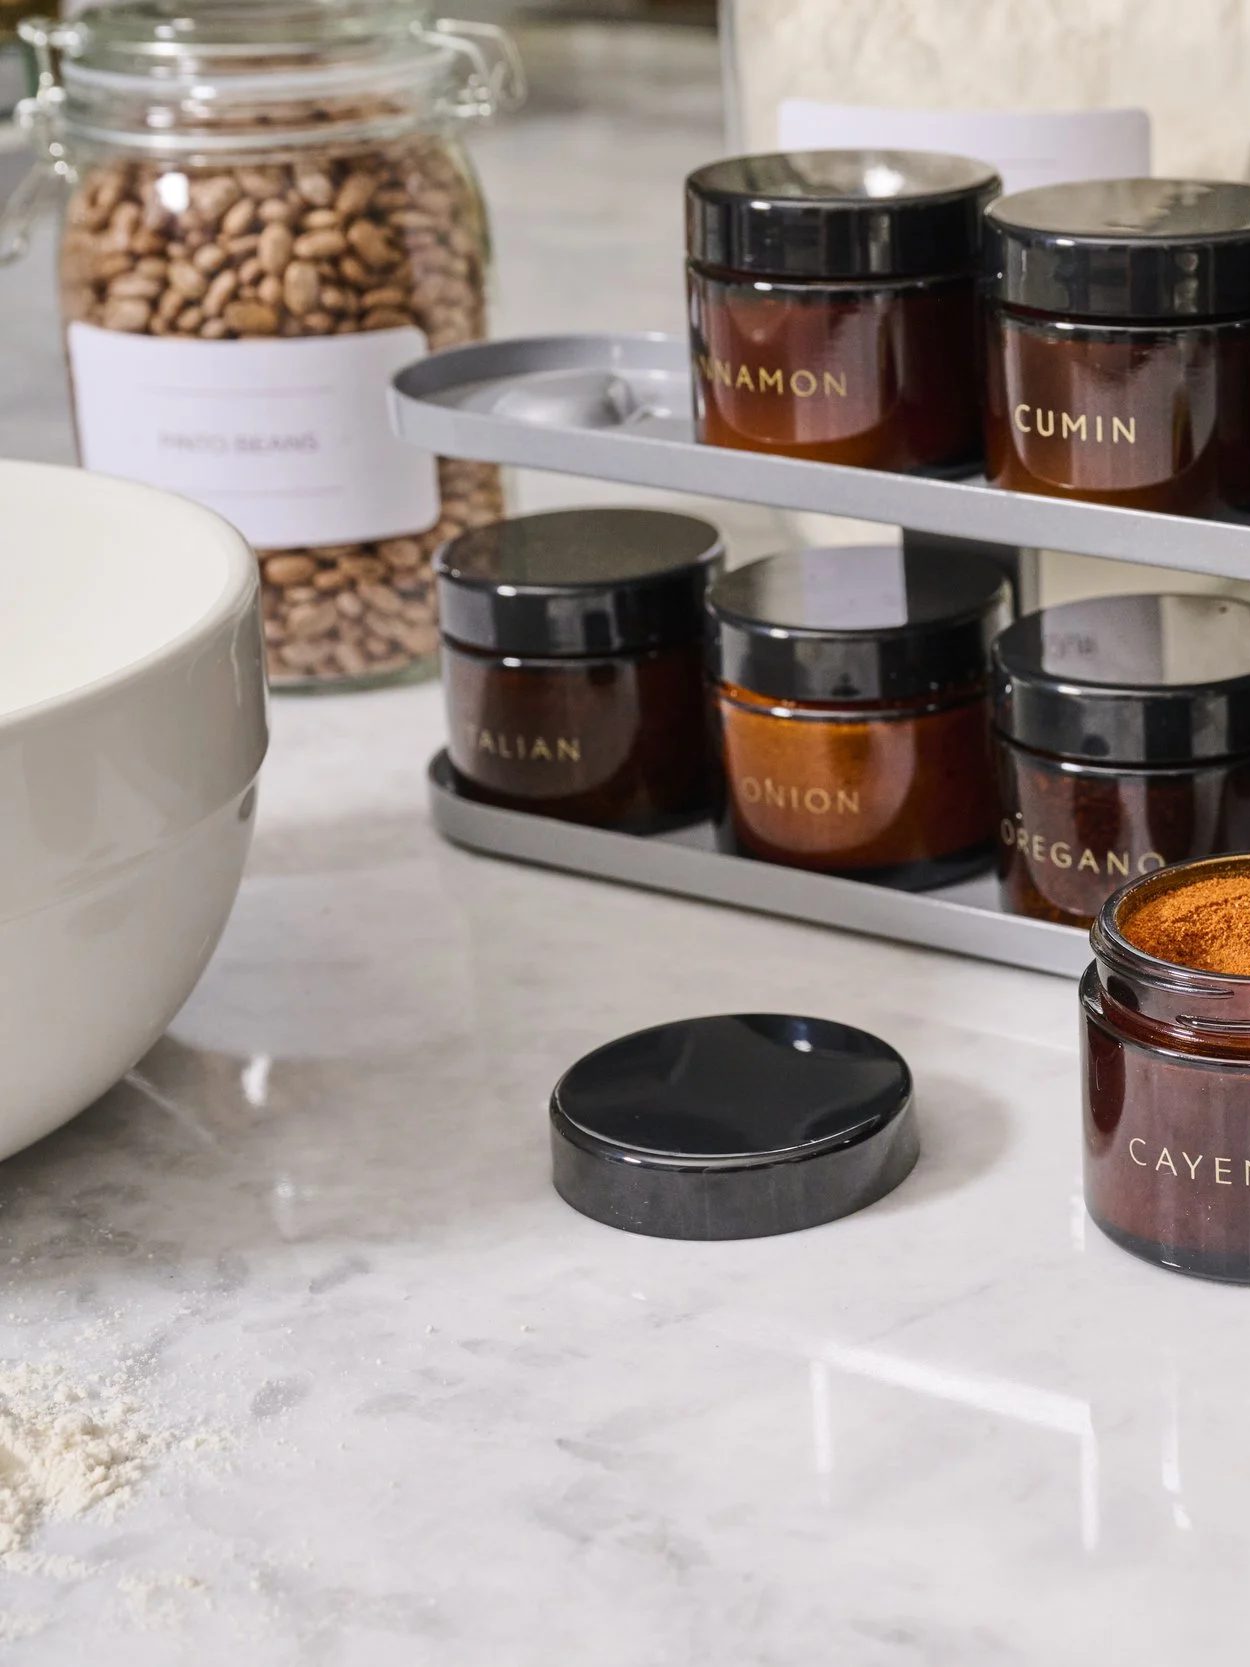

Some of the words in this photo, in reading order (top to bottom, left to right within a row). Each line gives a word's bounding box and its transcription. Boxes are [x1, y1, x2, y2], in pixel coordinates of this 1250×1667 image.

[694, 355, 847, 398] NNAMON
[1014, 403, 1136, 444] CUMIN
[465, 721, 581, 762] TALIAN
[741, 776, 859, 814] ONION
[1001, 818, 1166, 876] OREGANO
